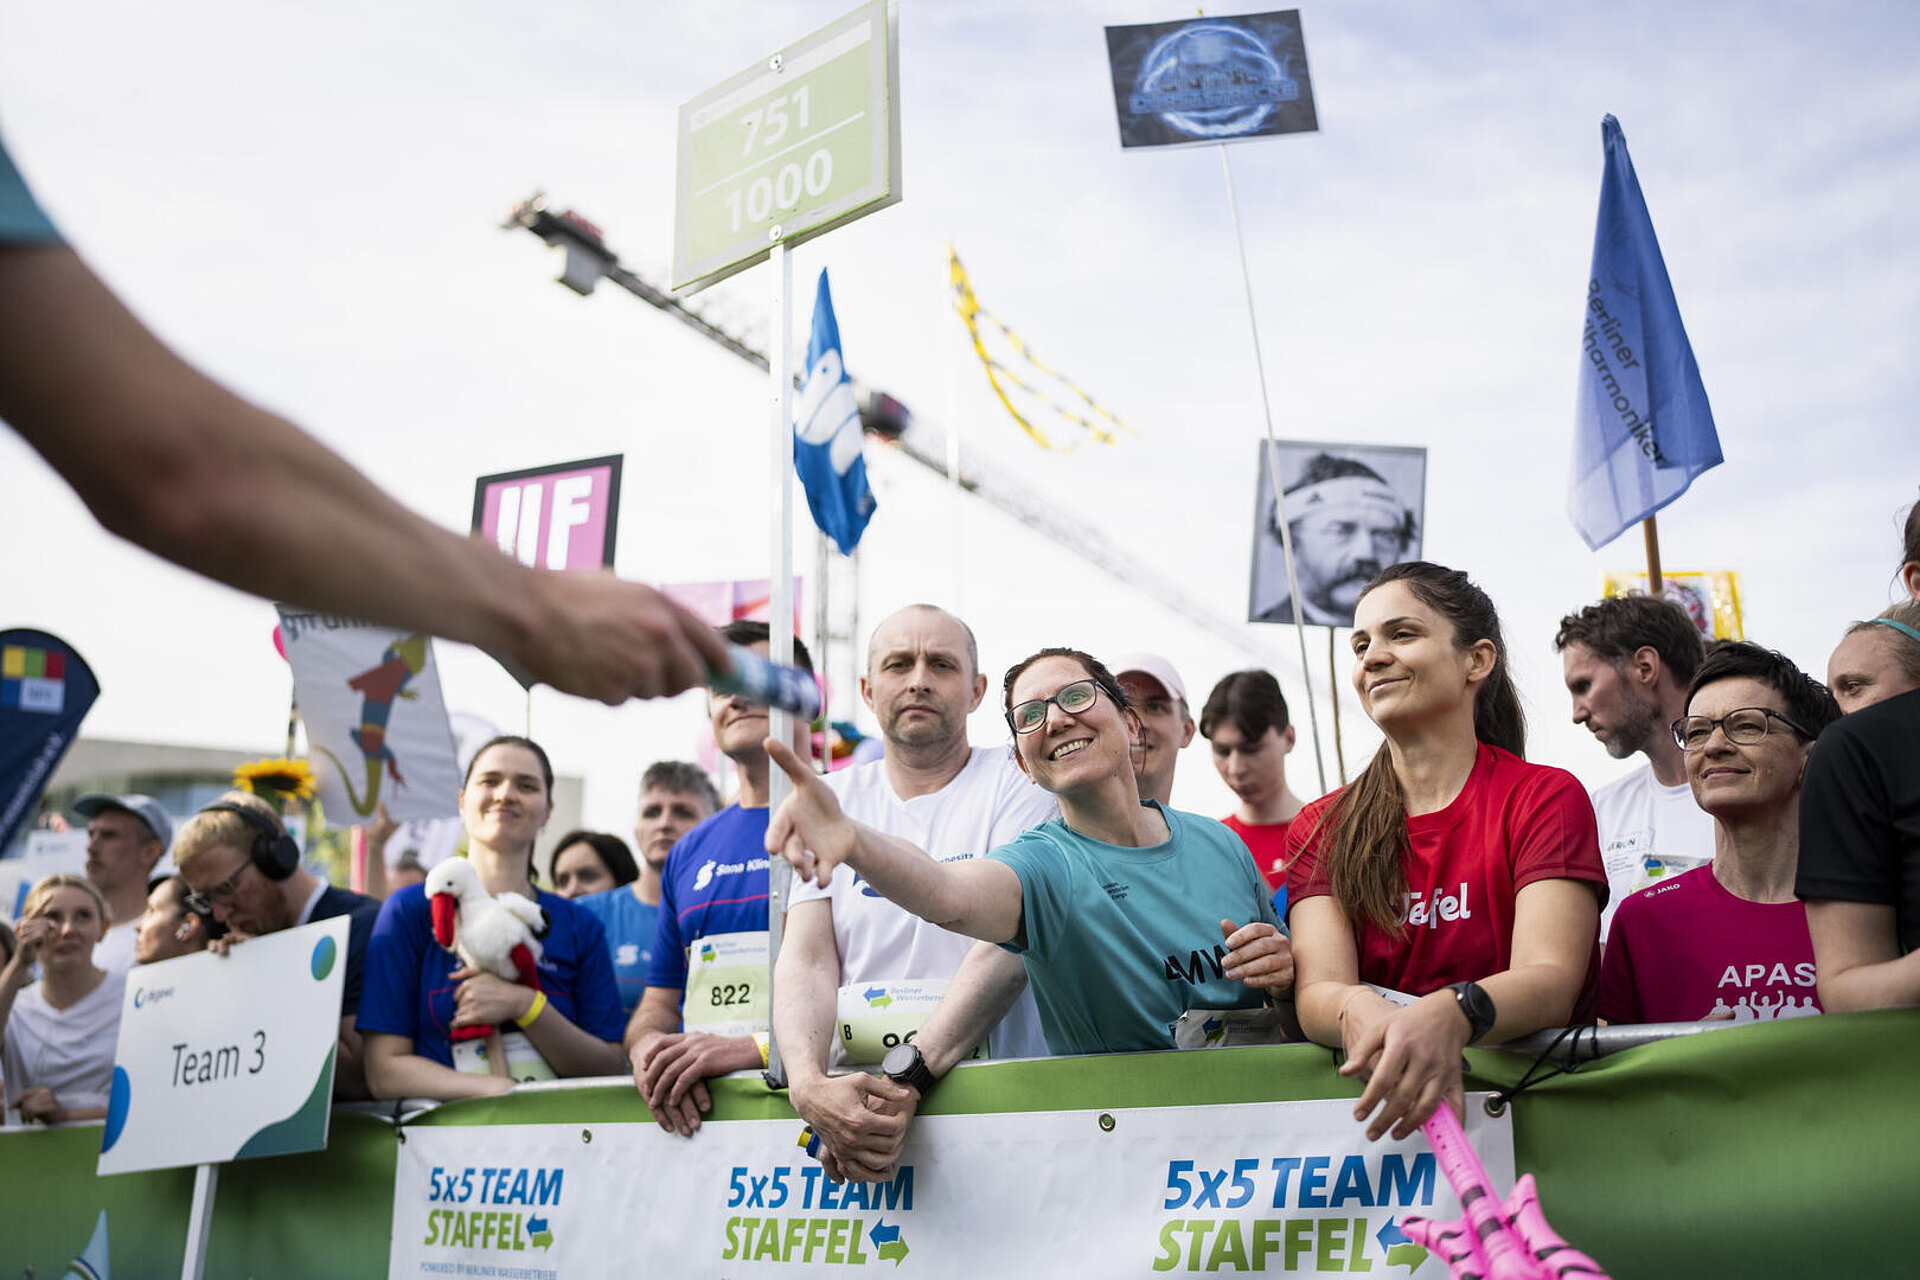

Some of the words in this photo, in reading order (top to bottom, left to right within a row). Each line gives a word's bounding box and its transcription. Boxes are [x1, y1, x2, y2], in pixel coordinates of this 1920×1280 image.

[739, 85, 810, 158] 751
[723, 148, 833, 232] 1000
[1657, 883, 1681, 894] JAKO
[711, 983, 750, 1006] 822
[1717, 962, 1817, 988] APAS
[843, 1024, 853, 1040] B
[172, 1043, 239, 1087] Team
[248, 1029, 266, 1074] 3
[429, 1166, 476, 1203] 5x5
[480, 1168, 564, 1206] TEAM
[727, 1166, 791, 1209] 5x5
[801, 1166, 914, 1211] TEAM
[1164, 1158, 1260, 1210] 5x5
[1271, 1152, 1437, 1209] TEAM
[424, 1208, 526, 1251] STAFFEL
[721, 1216, 868, 1265] STAFFEL
[1152, 1217, 1374, 1272] STAFFEL
[420, 1261, 455, 1274] POWERED
[465, 1264, 496, 1277] BERLINER
